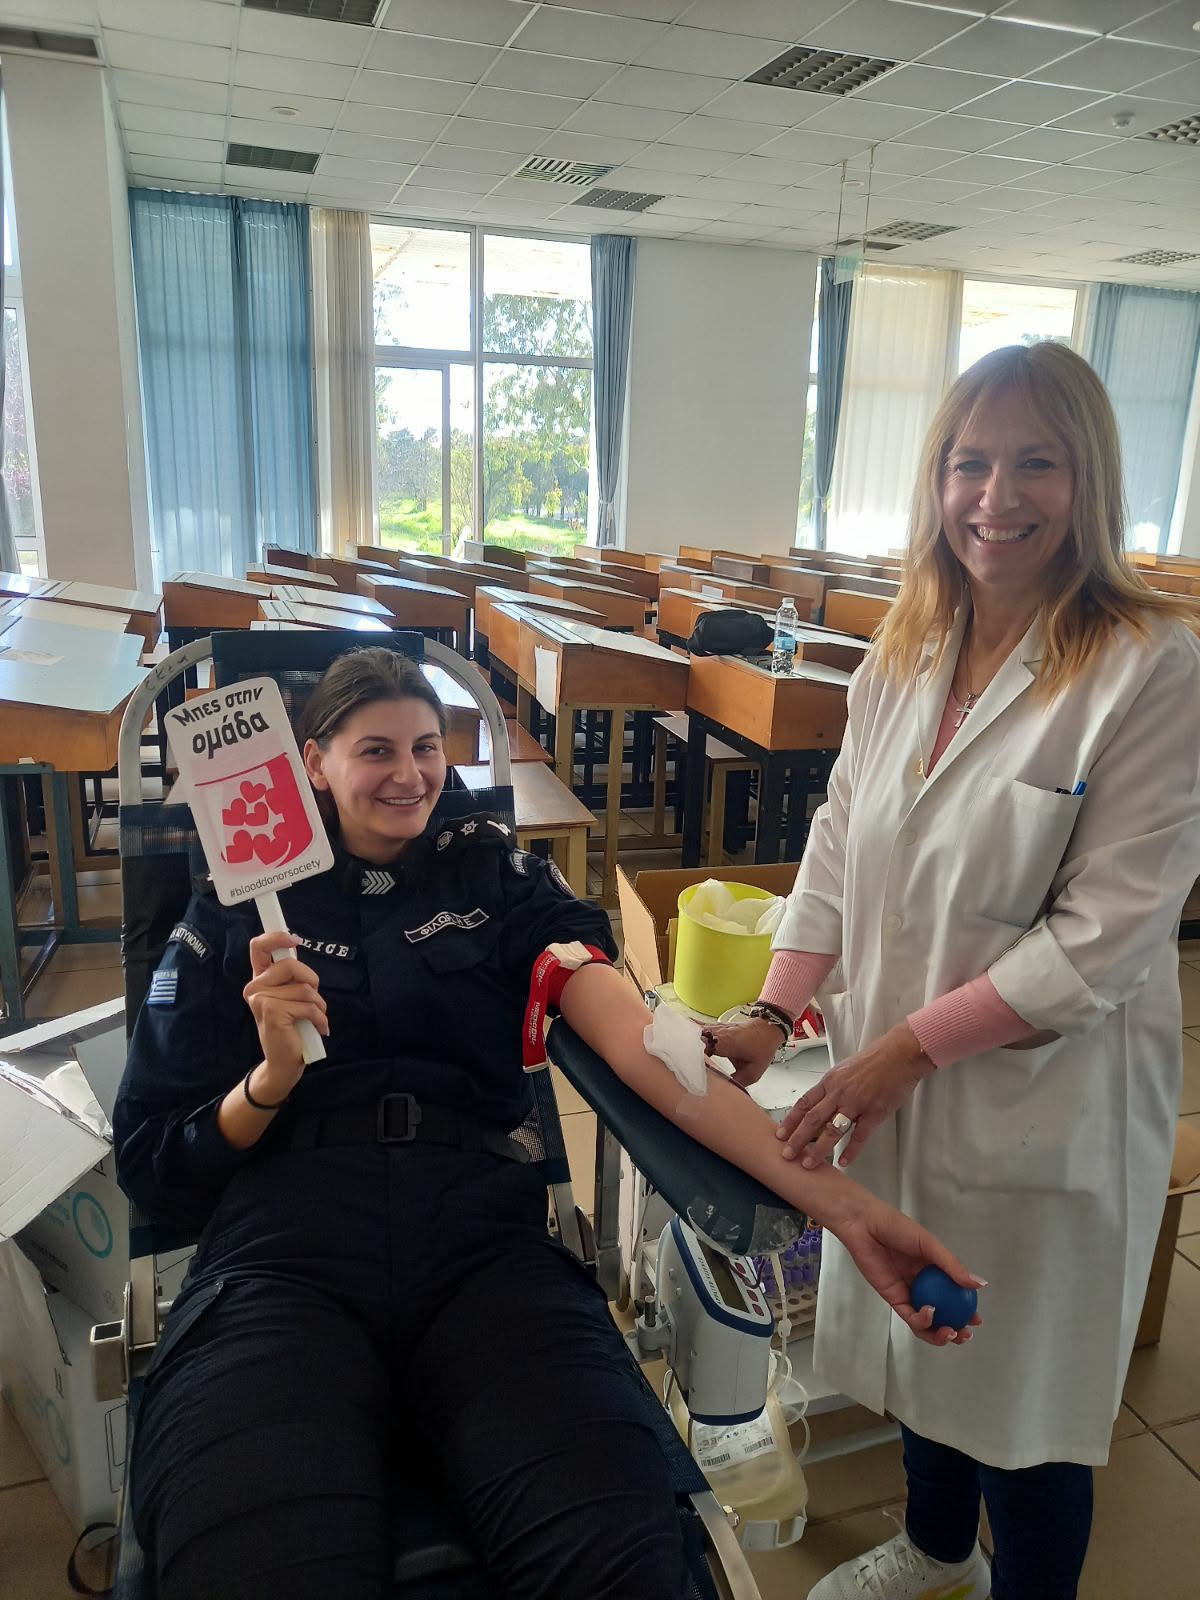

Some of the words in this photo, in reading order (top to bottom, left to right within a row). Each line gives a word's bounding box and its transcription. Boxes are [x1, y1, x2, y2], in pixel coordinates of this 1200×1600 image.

[172, 698, 222, 727] Μπες
[225, 686, 264, 707] στην
[192, 710, 270, 760] ομάδα
[230, 859, 321, 898] #blooddonorsociety
[302, 938, 349, 958] LICE
